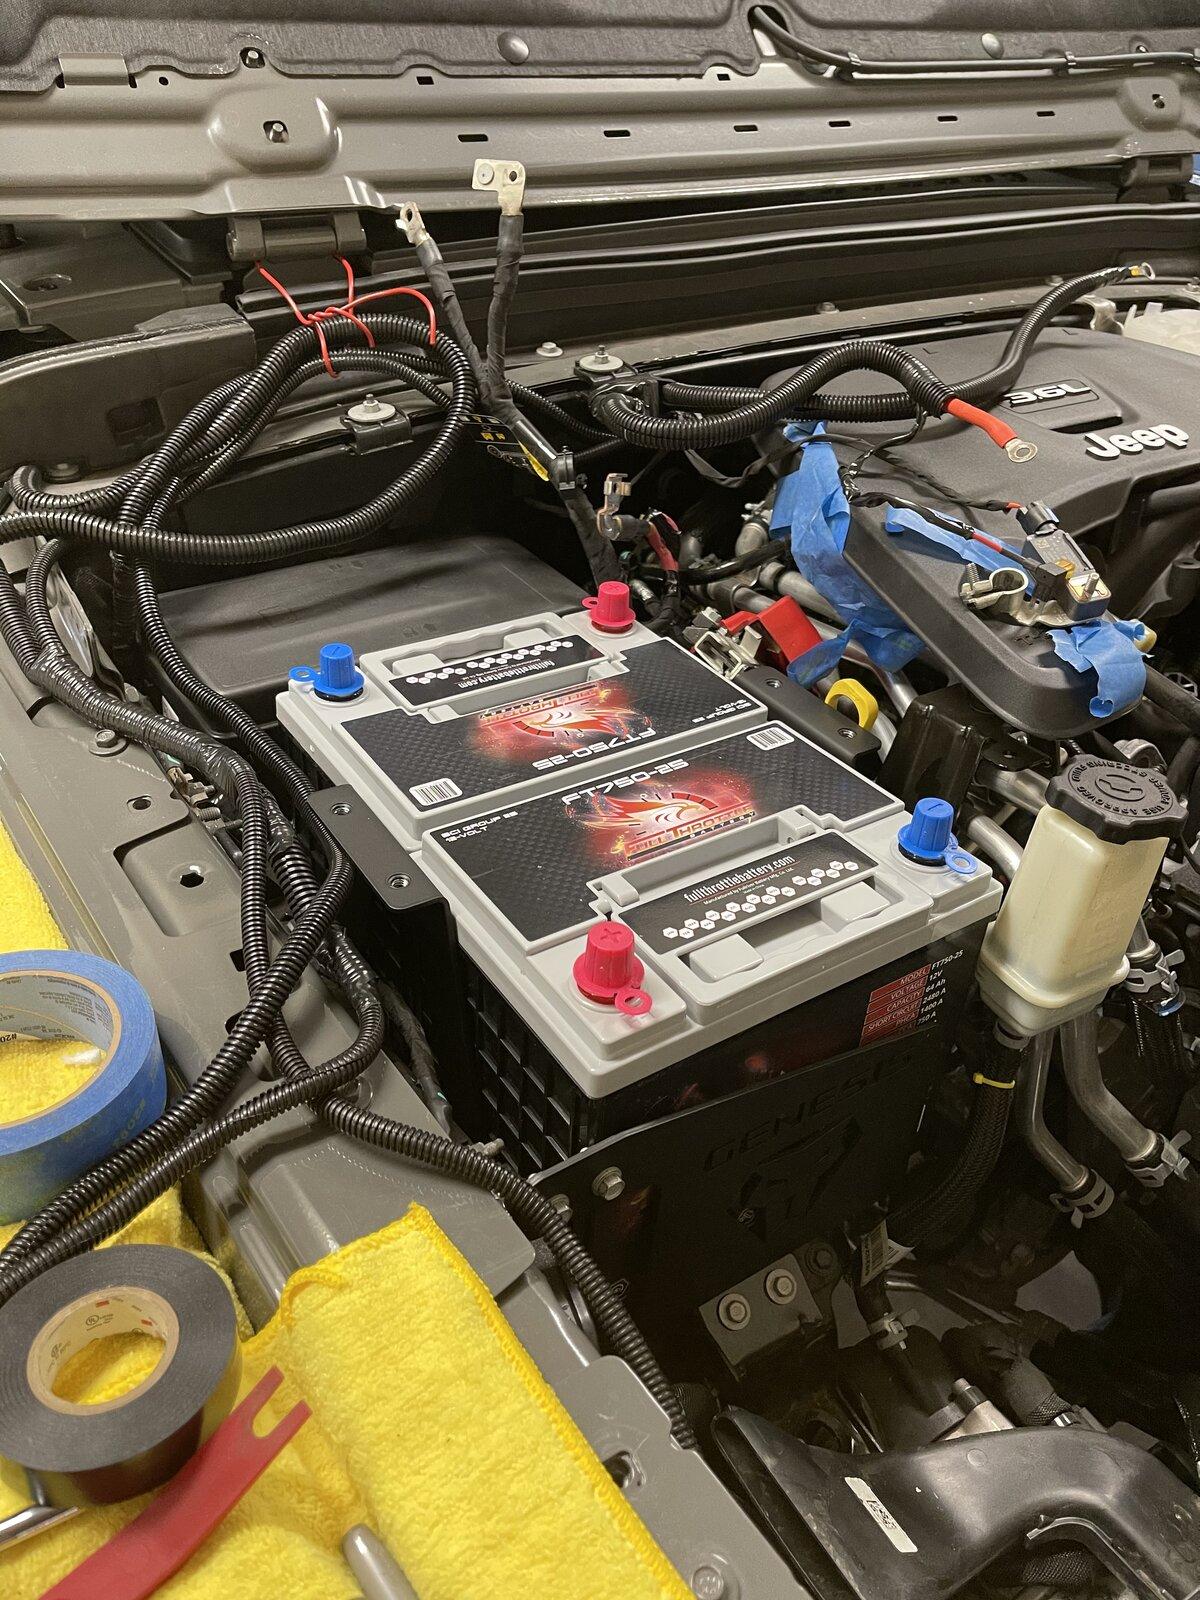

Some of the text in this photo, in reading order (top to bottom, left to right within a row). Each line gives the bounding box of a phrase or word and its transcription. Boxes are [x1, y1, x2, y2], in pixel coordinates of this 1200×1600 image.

[1003, 384, 1091, 405] 3.6L
[1084, 424, 1190, 458] Jeep
[532, 728, 657, 770] FT750-25
[562, 759, 690, 805] FT750-25
[1076, 786, 1138, 816] APPROVED
[441, 828, 462, 839] SCI
[462, 815, 502, 832] GROUP
[683, 855, 796, 903] fullthrottlebattery.com
[900, 949, 964, 985] MODEL FT750-25
[886, 978, 946, 1012] CAPACITY 64 Ah
[890, 969, 943, 1000] VOLTAGE 12V
[920, 1003, 937, 1014] 1400
[929, 1010, 936, 1018] A
